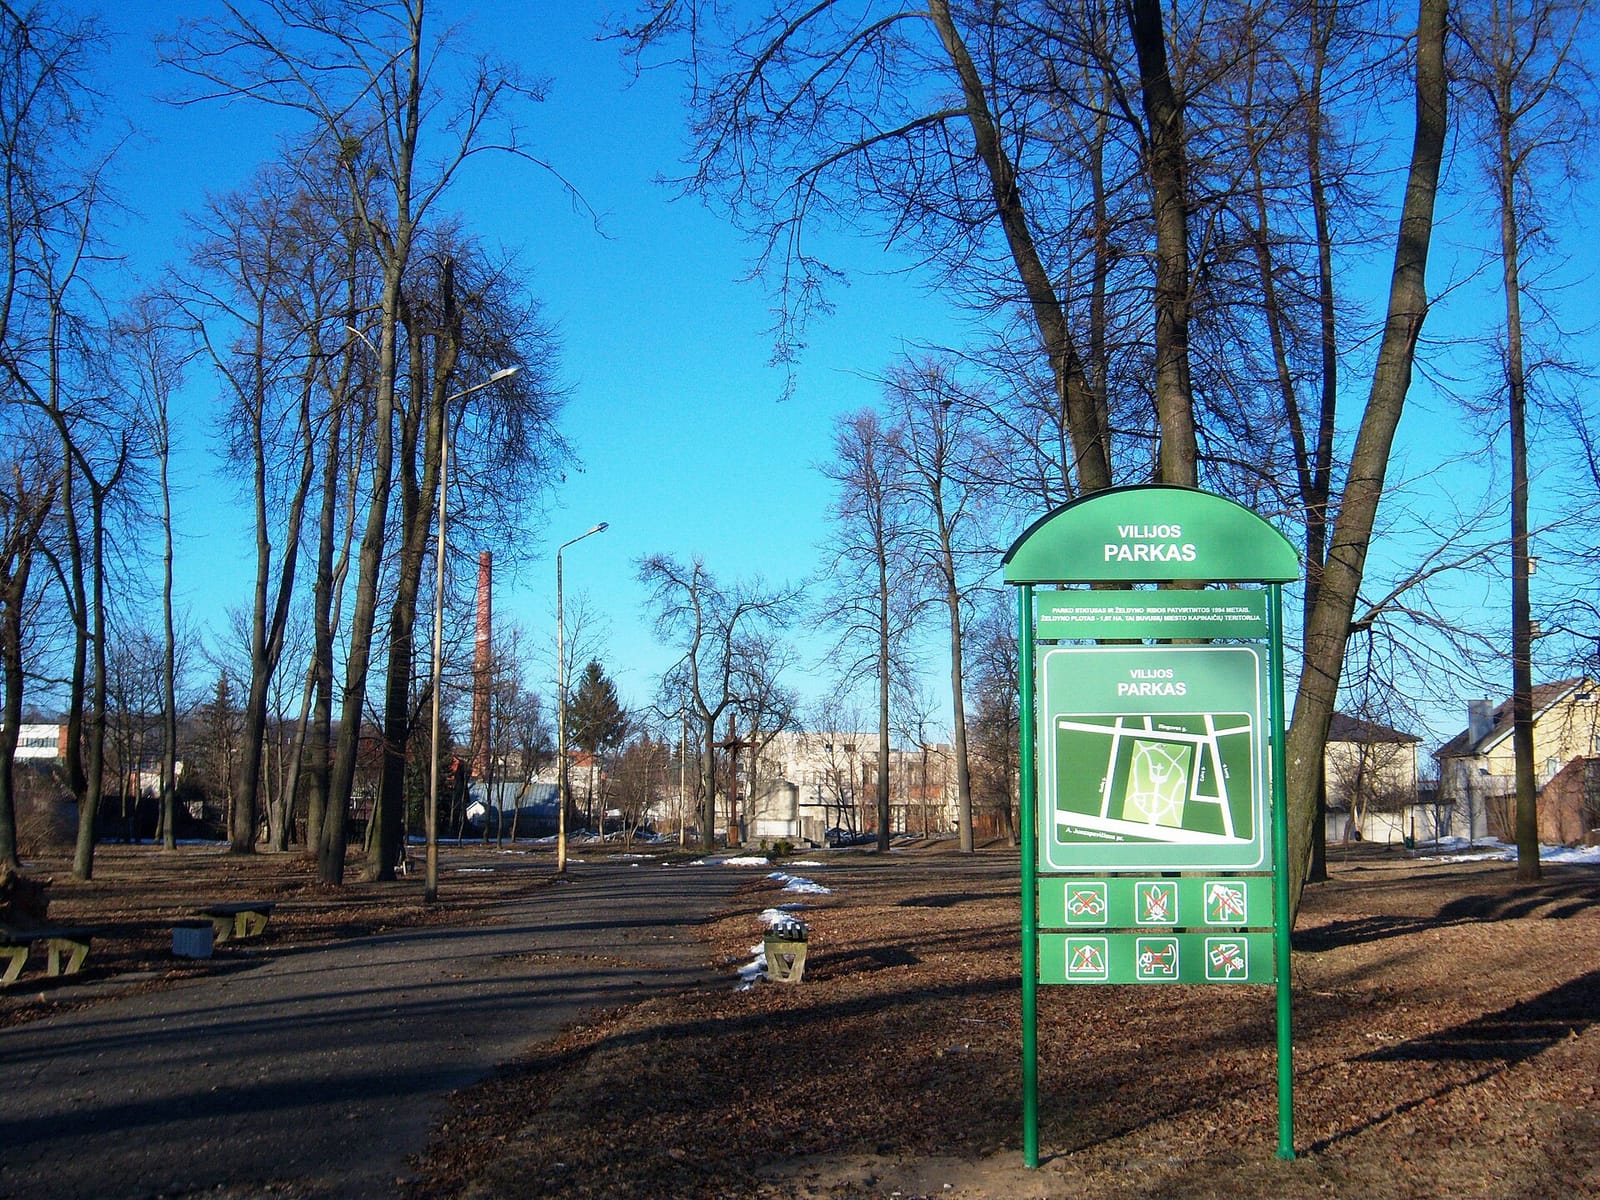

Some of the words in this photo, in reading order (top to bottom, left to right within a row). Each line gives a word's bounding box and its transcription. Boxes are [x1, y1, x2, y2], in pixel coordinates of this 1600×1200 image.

[1117, 524, 1182, 538] VILIJOS
[1104, 543, 1197, 562] PARKAS
[1130, 669, 1174, 679] VILIJOS
[1117, 682, 1187, 697] PARKAS
